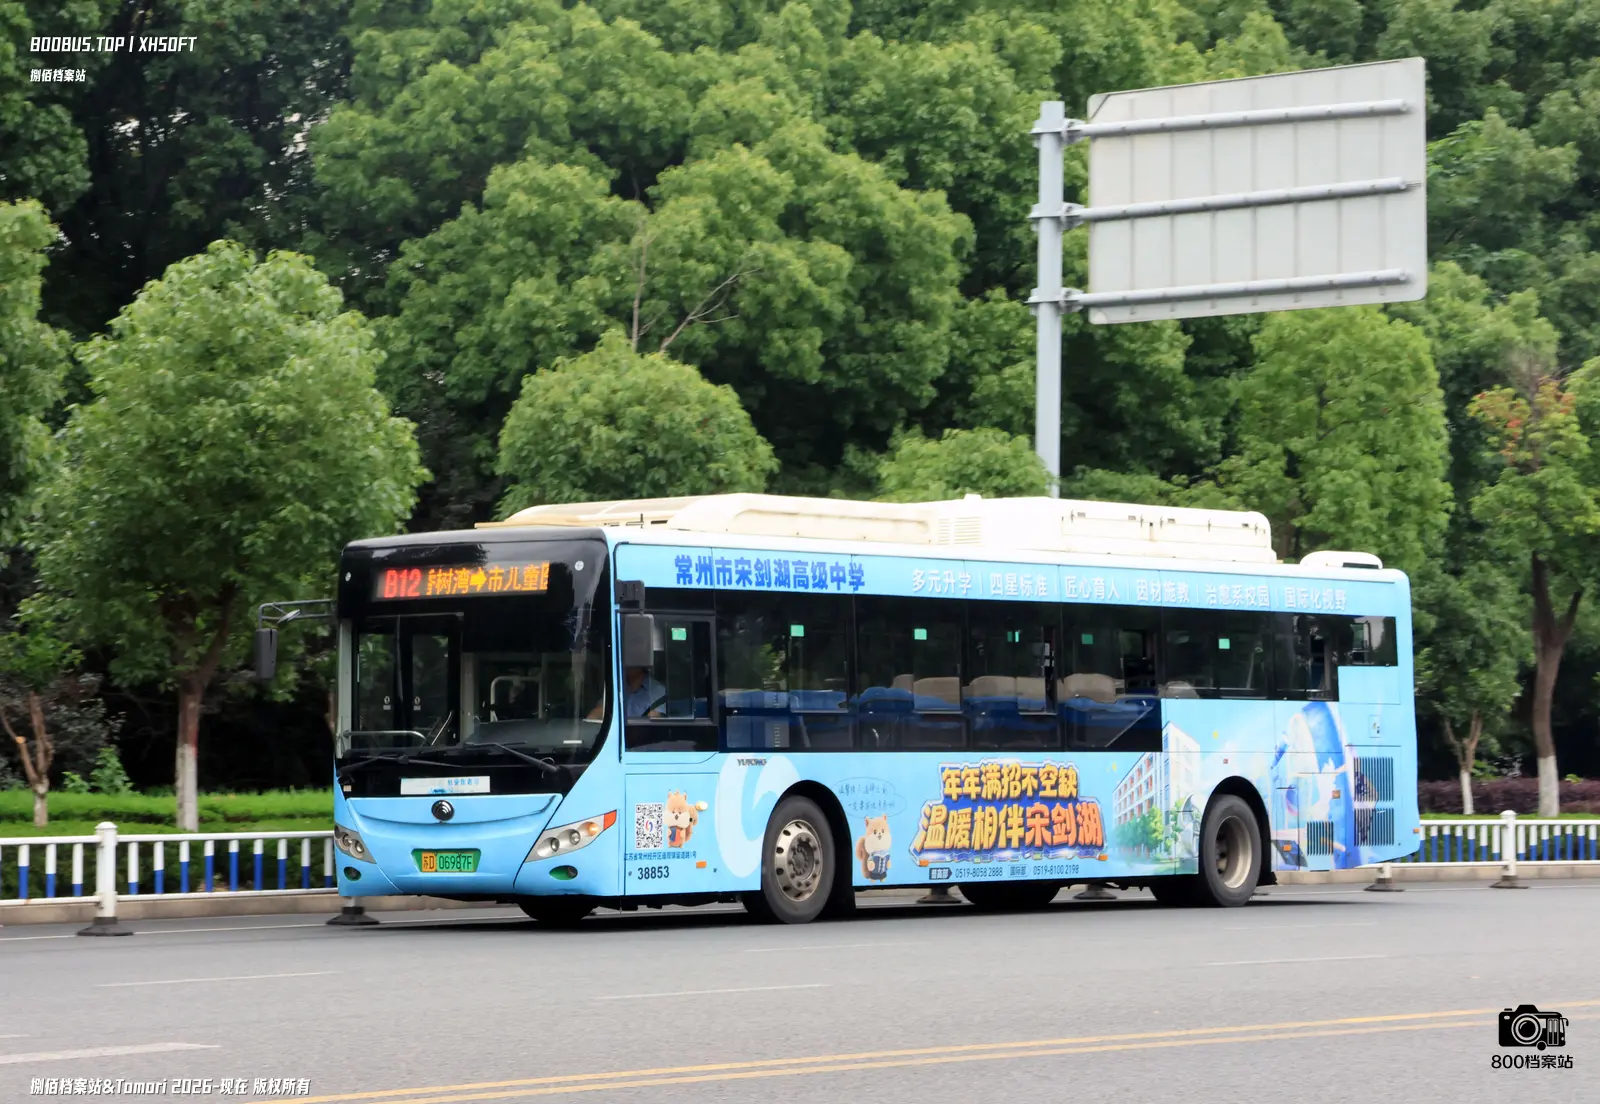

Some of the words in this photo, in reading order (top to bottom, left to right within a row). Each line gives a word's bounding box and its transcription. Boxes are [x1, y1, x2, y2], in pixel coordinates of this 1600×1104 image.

[384, 568, 422, 598] B12
[674, 554, 865, 592] 常州市宋剑湖高级中学
[911, 568, 973, 596] 多元升学
[989, 572, 1048, 597] 四星标准
[1064, 575, 1121, 600] 匠心育人
[1135, 579, 1190, 603] 因材施教
[1205, 582, 1271, 608] 治愈系校园
[1283, 586, 1347, 611] 国际化视野
[942, 763, 1079, 800] 年年满招不空缺
[914, 802, 1104, 851] 温暖相伴宋剑湖
[637, 866, 670, 880] 38853
